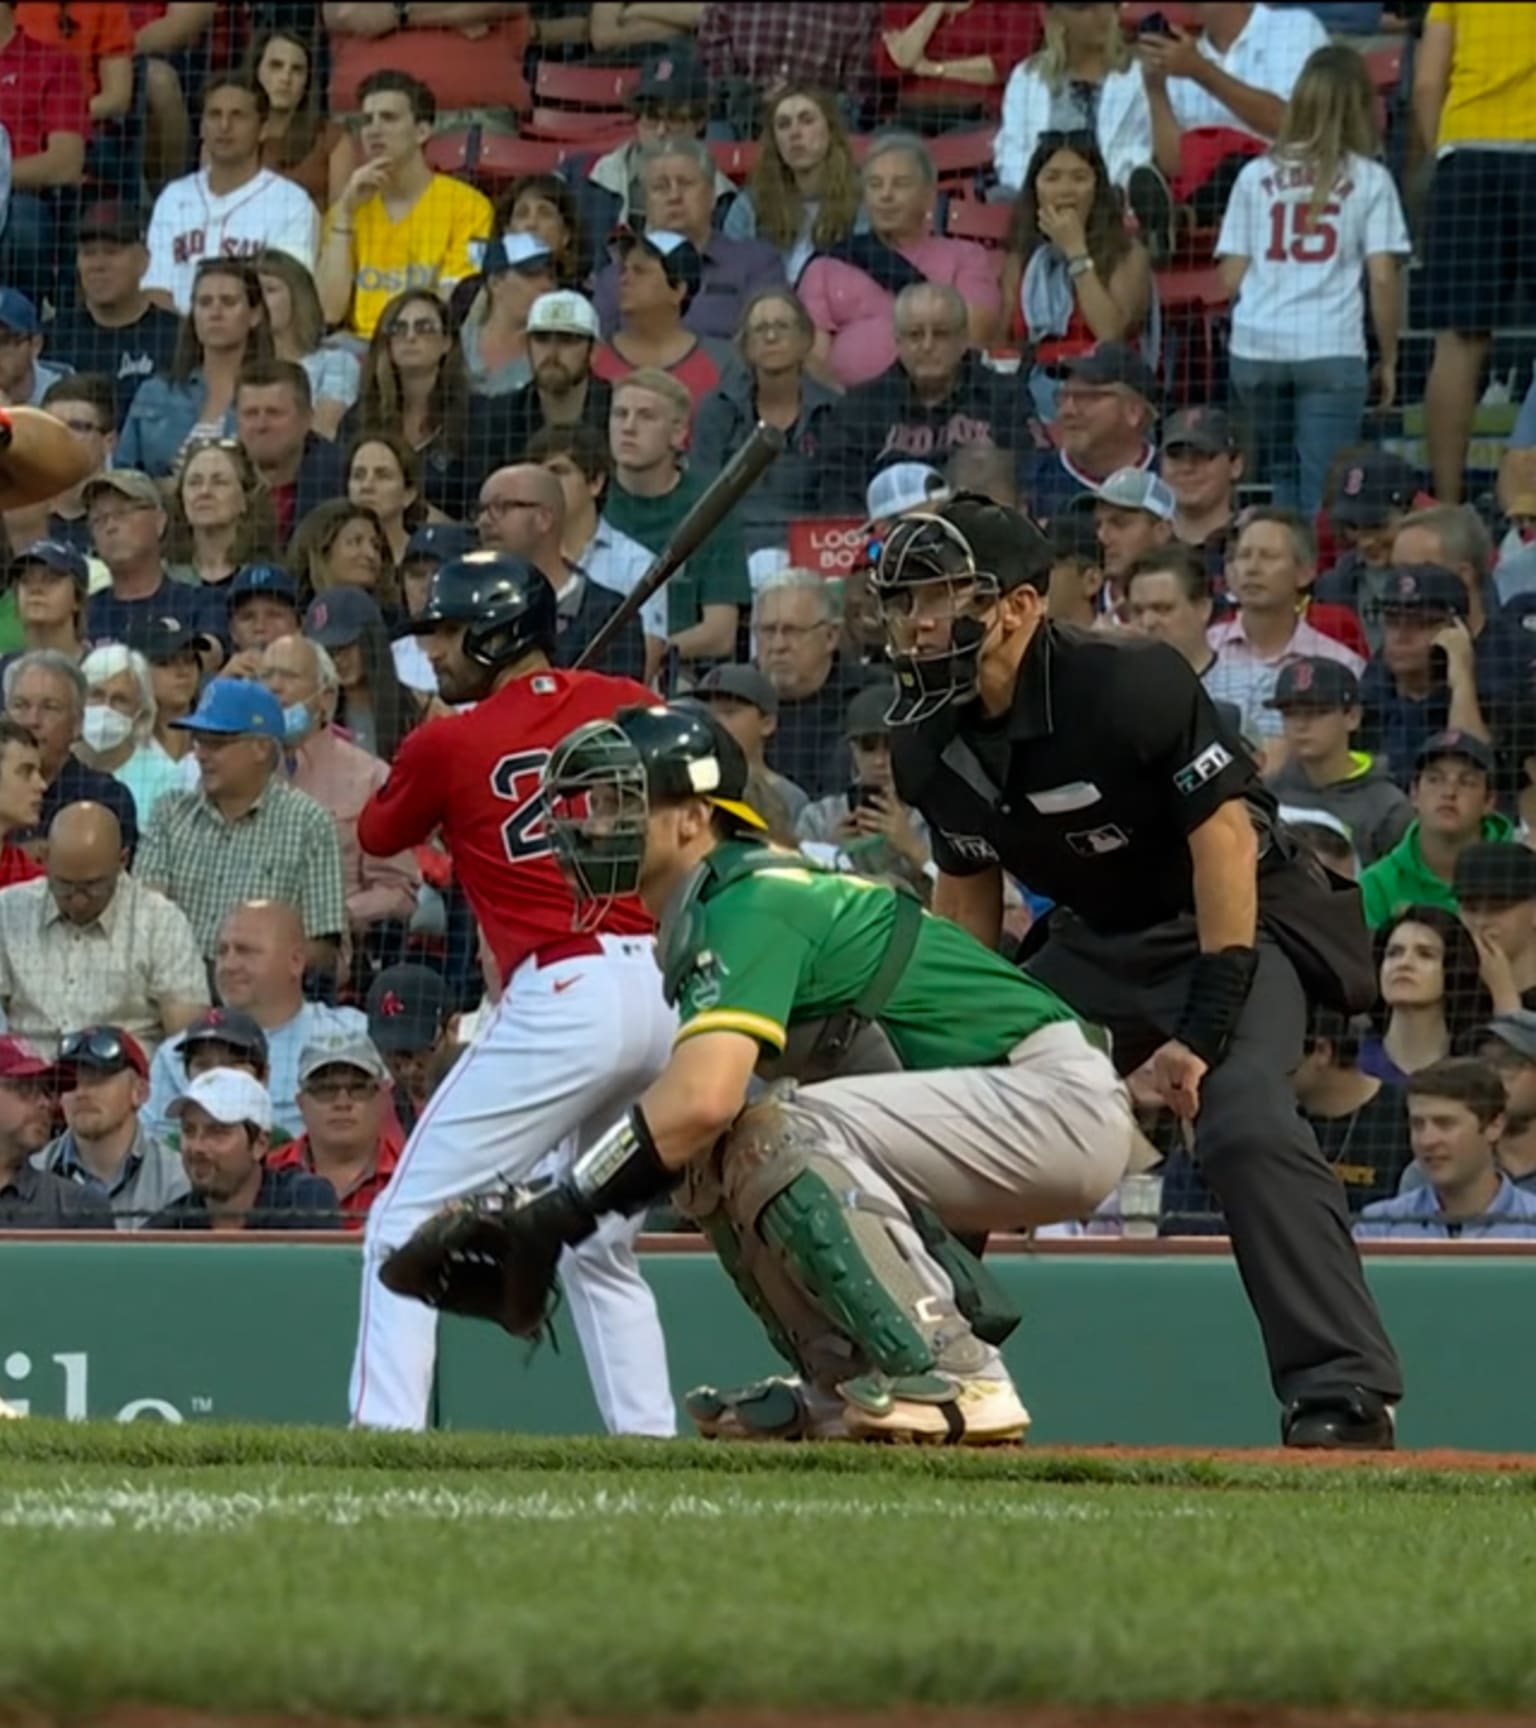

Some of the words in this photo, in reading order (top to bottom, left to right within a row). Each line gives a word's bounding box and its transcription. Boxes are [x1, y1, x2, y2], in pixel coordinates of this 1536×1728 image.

[1265, 201, 1341, 264] 15
[810, 529, 869, 548] LOG
[820, 549, 861, 568] BO
